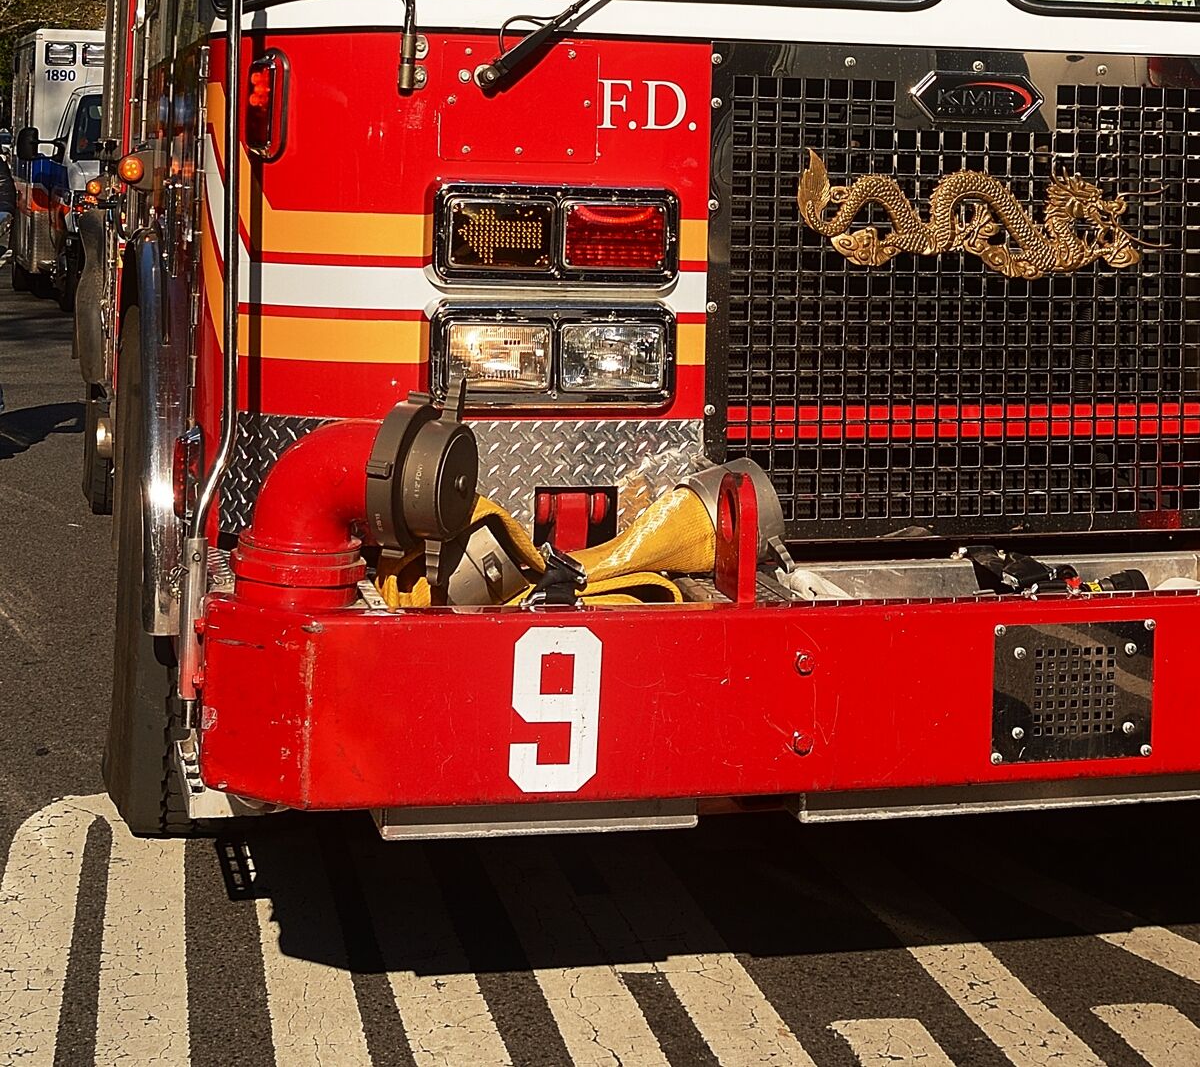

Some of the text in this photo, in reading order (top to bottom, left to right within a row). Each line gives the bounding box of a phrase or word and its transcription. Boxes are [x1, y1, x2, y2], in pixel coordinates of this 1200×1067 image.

[44, 69, 76, 81] 1890
[597, 79, 697, 131] F.D.
[508, 626, 603, 793] 9
